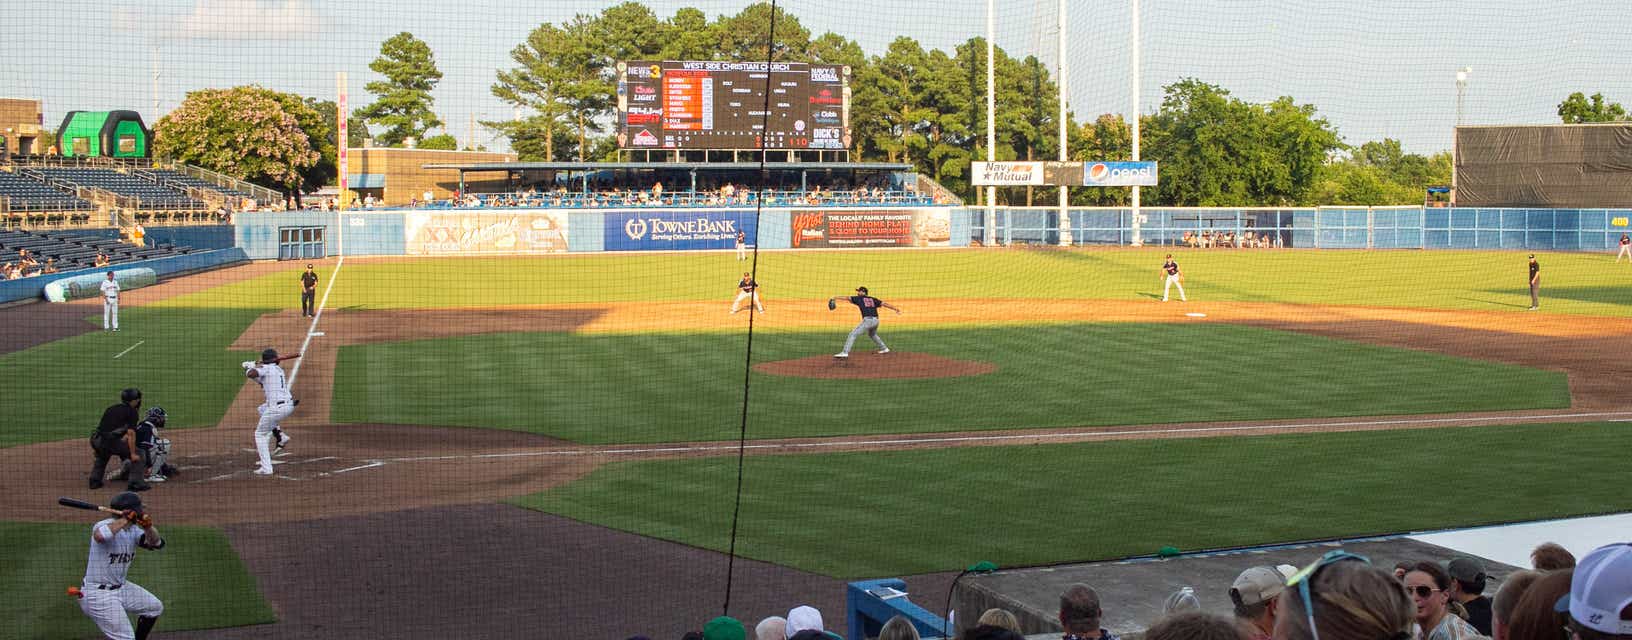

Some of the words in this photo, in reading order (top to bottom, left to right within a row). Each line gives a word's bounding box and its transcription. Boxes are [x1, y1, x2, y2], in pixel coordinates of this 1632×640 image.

[650, 64, 660, 78] 3
[722, 62, 759, 70] CHRISTIAN
[814, 128, 840, 138] DICK'S
[985, 162, 1012, 172] Navy
[1112, 166, 1151, 178] pepsi
[993, 172, 1032, 181] Mutual
[1612, 216, 1628, 226] 400
